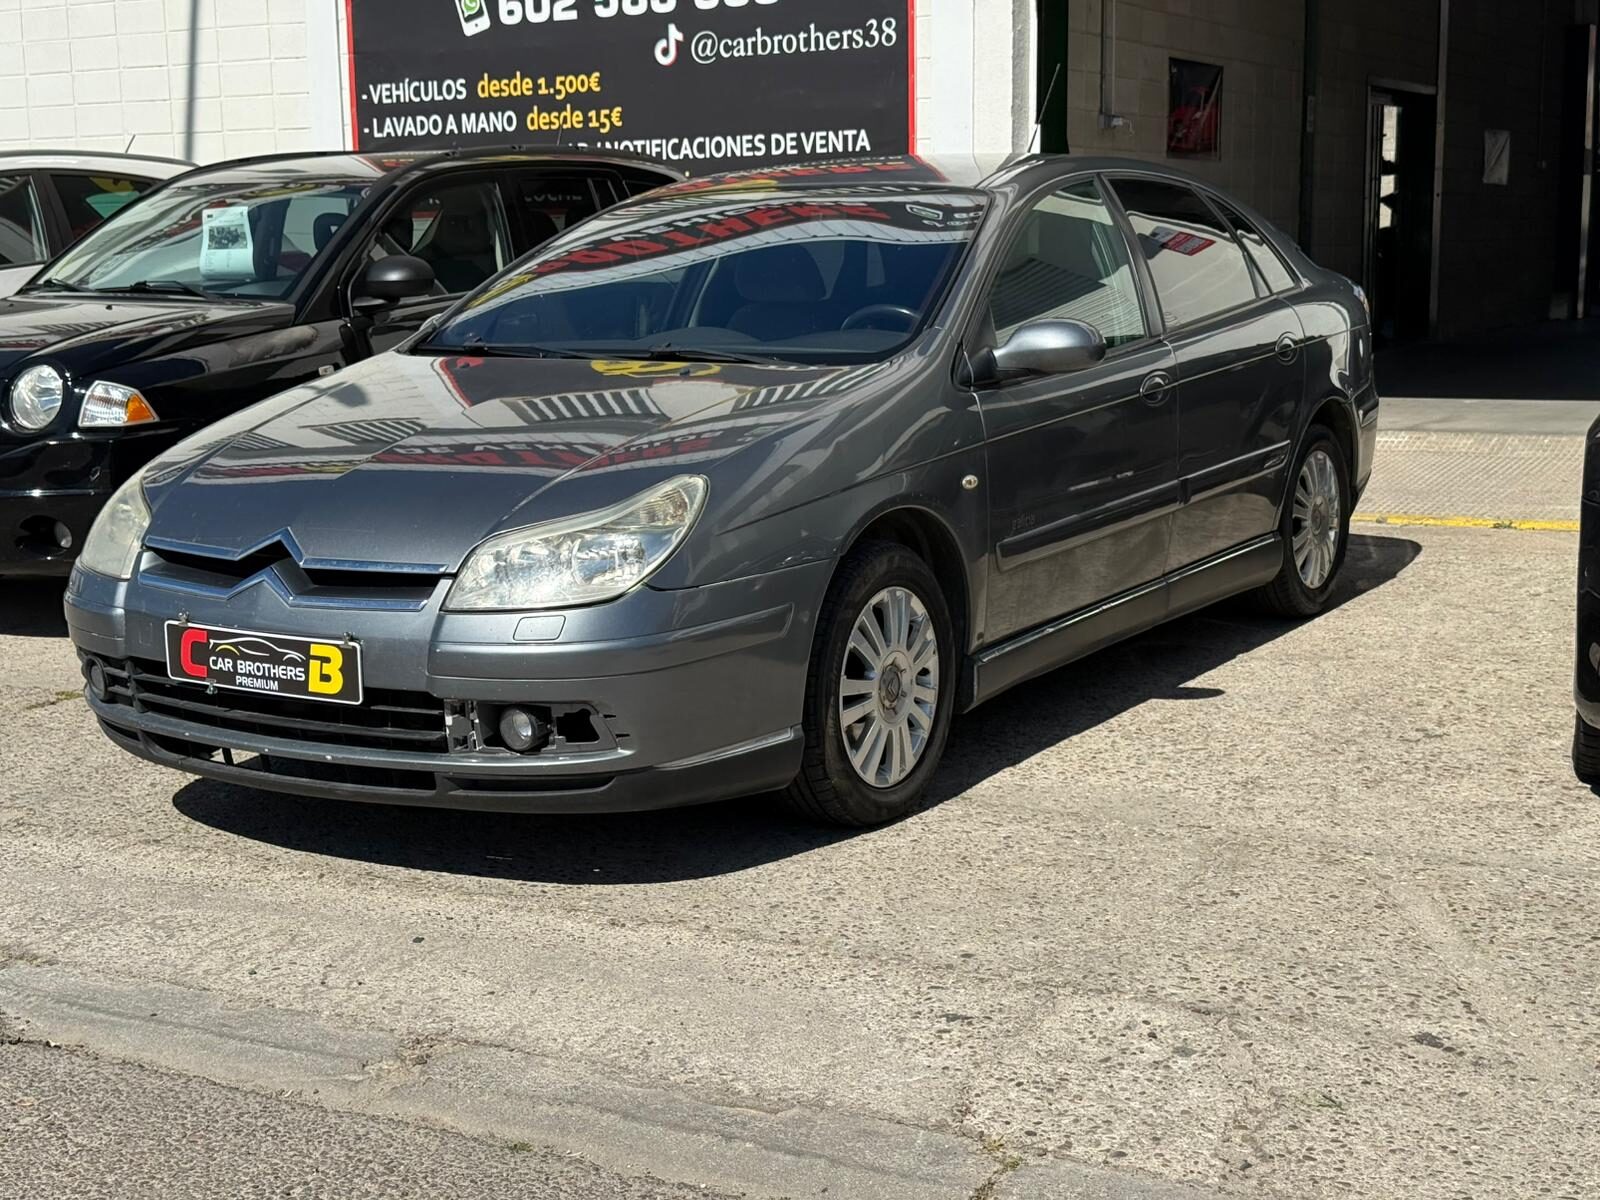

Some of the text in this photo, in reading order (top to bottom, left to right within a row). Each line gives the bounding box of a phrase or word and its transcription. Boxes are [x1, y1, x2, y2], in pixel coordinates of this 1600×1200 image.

[691, 17, 897, 65] @carbrothers38
[477, 71, 533, 98] desde
[538, 71, 601, 99] 1.500€
[445, 113, 459, 135] A
[461, 110, 517, 134] MANO
[526, 103, 584, 131] desde
[588, 106, 623, 133] 15€
[770, 132, 799, 156] DE
[799, 128, 871, 155] VENTA
[209, 656, 306, 682] CAR BROTHERS
[235, 675, 279, 691] PREMIUM
